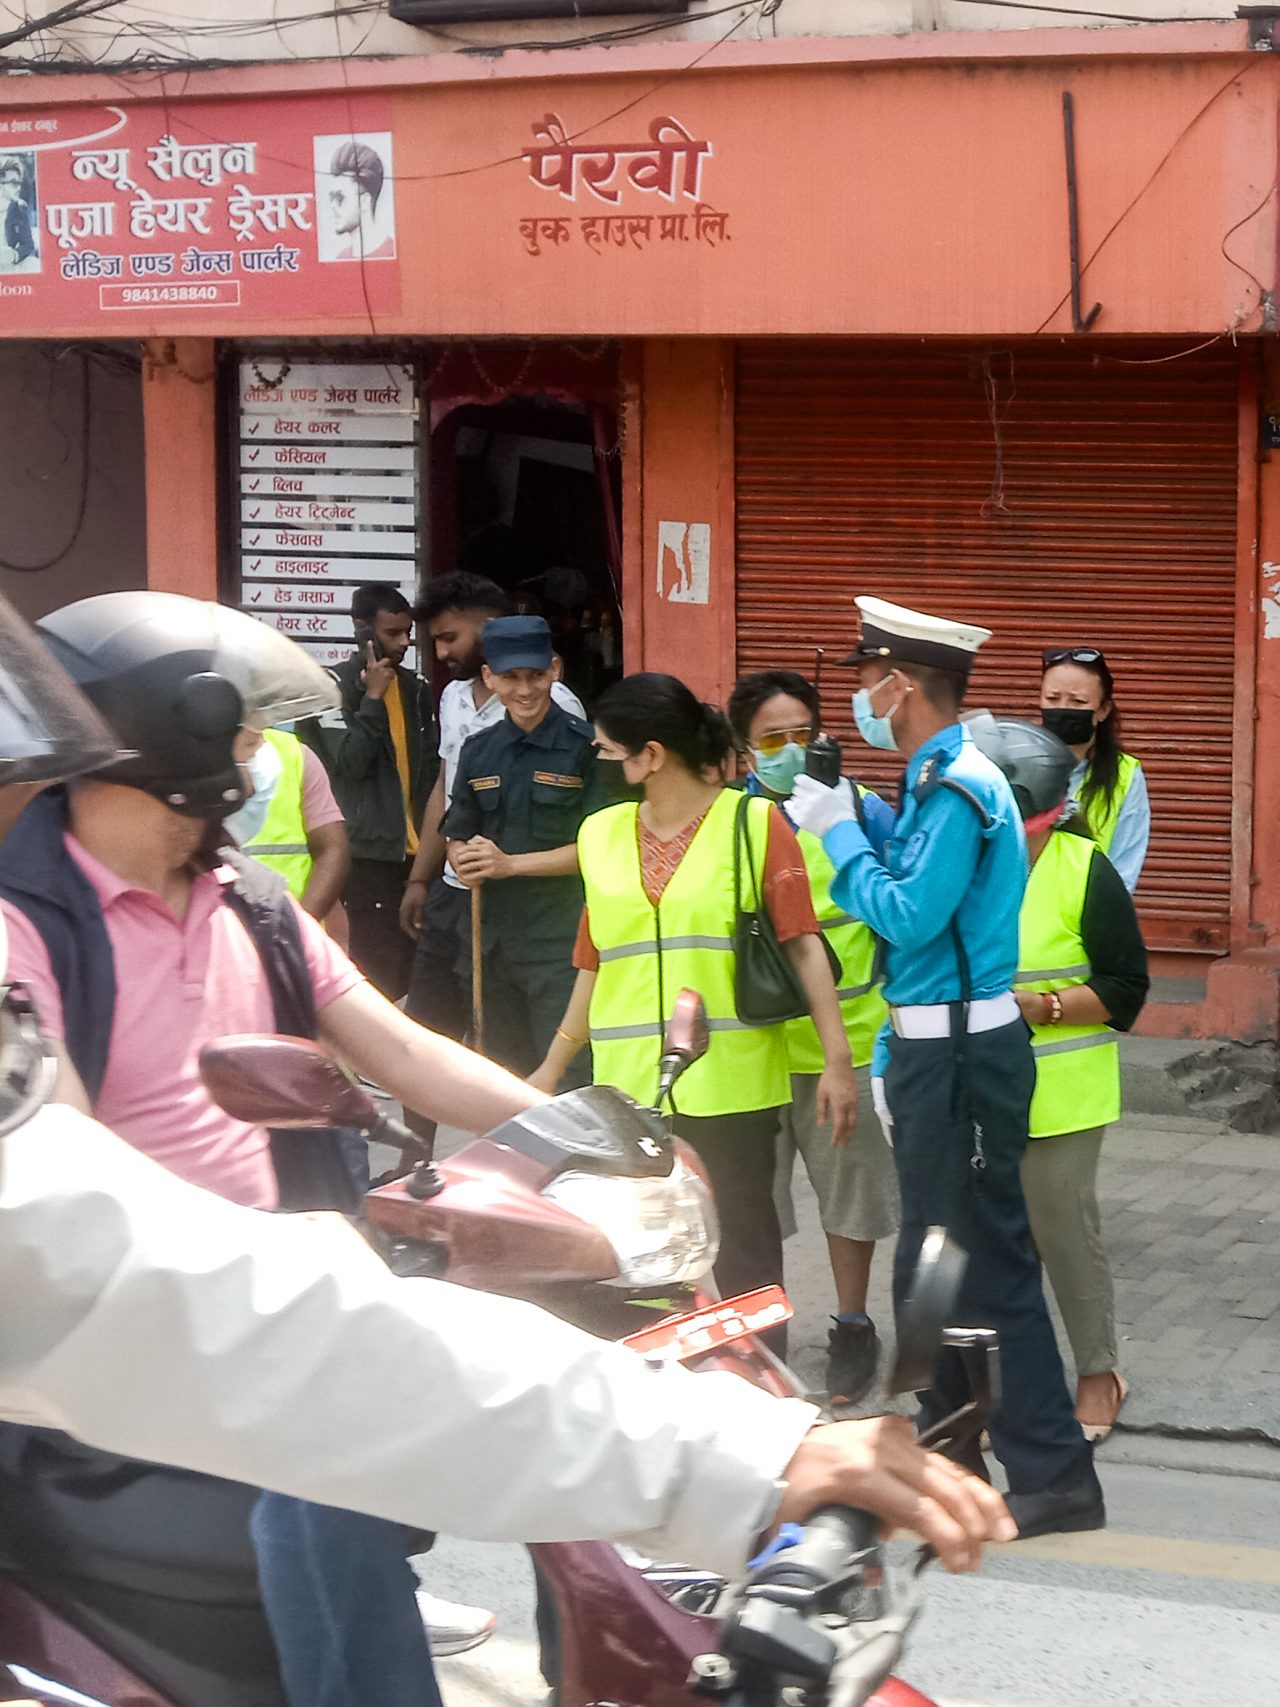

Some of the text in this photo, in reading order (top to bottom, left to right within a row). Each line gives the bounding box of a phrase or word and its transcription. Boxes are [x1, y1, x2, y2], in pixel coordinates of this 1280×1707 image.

[71, 135, 257, 190] न्यू सैलुन
[521, 112, 713, 206] पैरवी
[46, 184, 314, 248] पूजा हेयर ड्रेसर
[519, 217, 571, 256] बुक
[580, 215, 654, 255] हाउस
[61, 243, 300, 279] लेडिज एण्ड जेन्स पार्लर
[0, 281, 32, 296] loon
[122, 285, 218, 303] 9841438840
[291, 388, 318, 402] एण्ड
[324, 385, 357, 403] जेन्स
[364, 385, 401, 403] पार्लर
[274, 417, 341, 434] हेयर कलर
[275, 448, 326, 464] फेसियल
[275, 502, 303, 519] हेयर
[275, 560, 329, 575] हाइलाइट
[274, 586, 335, 604] हेड मसाज
[276, 614, 301, 631] हेयर
